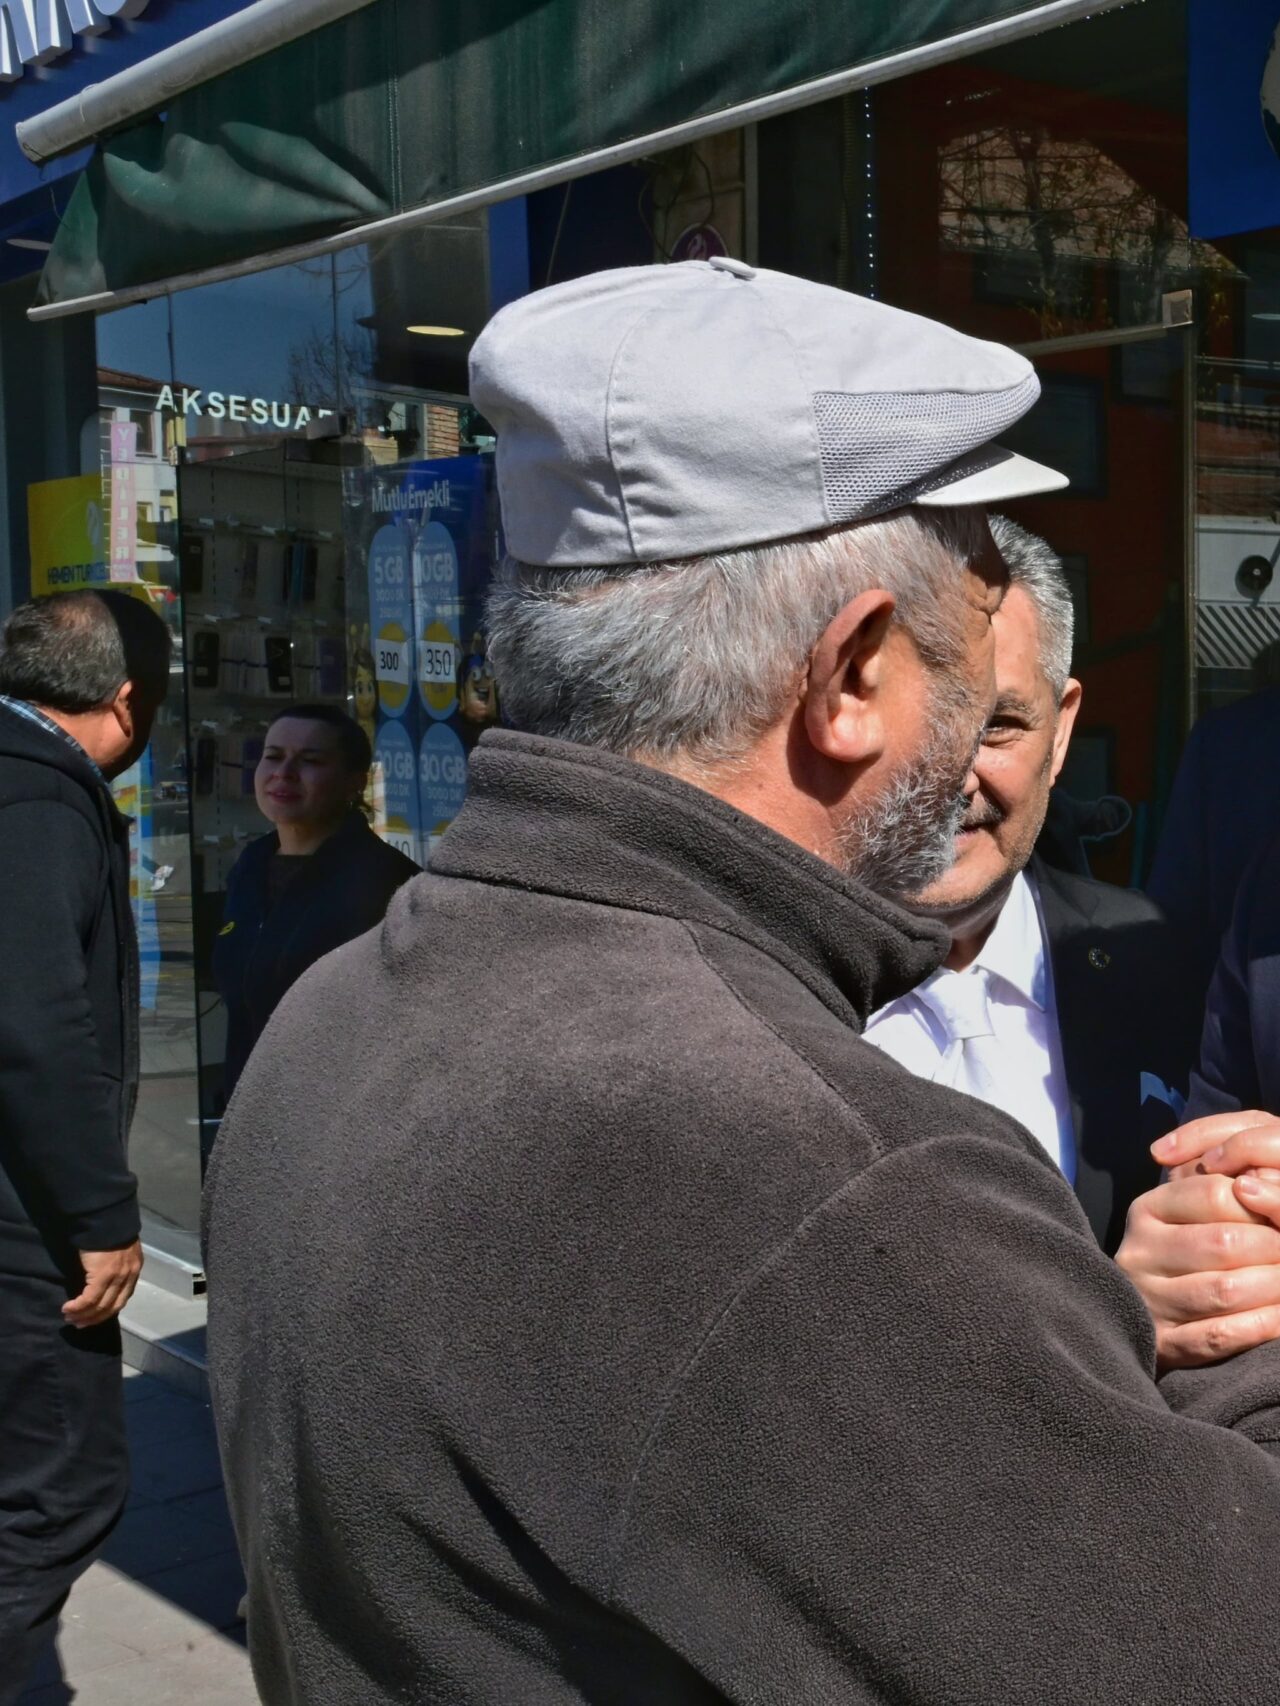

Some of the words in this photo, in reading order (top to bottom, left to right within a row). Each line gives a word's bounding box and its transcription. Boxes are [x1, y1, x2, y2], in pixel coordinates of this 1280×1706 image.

[155, 384, 333, 430] AKSESUA
[380, 651, 399, 670] 300
[426, 648, 452, 676] 350
